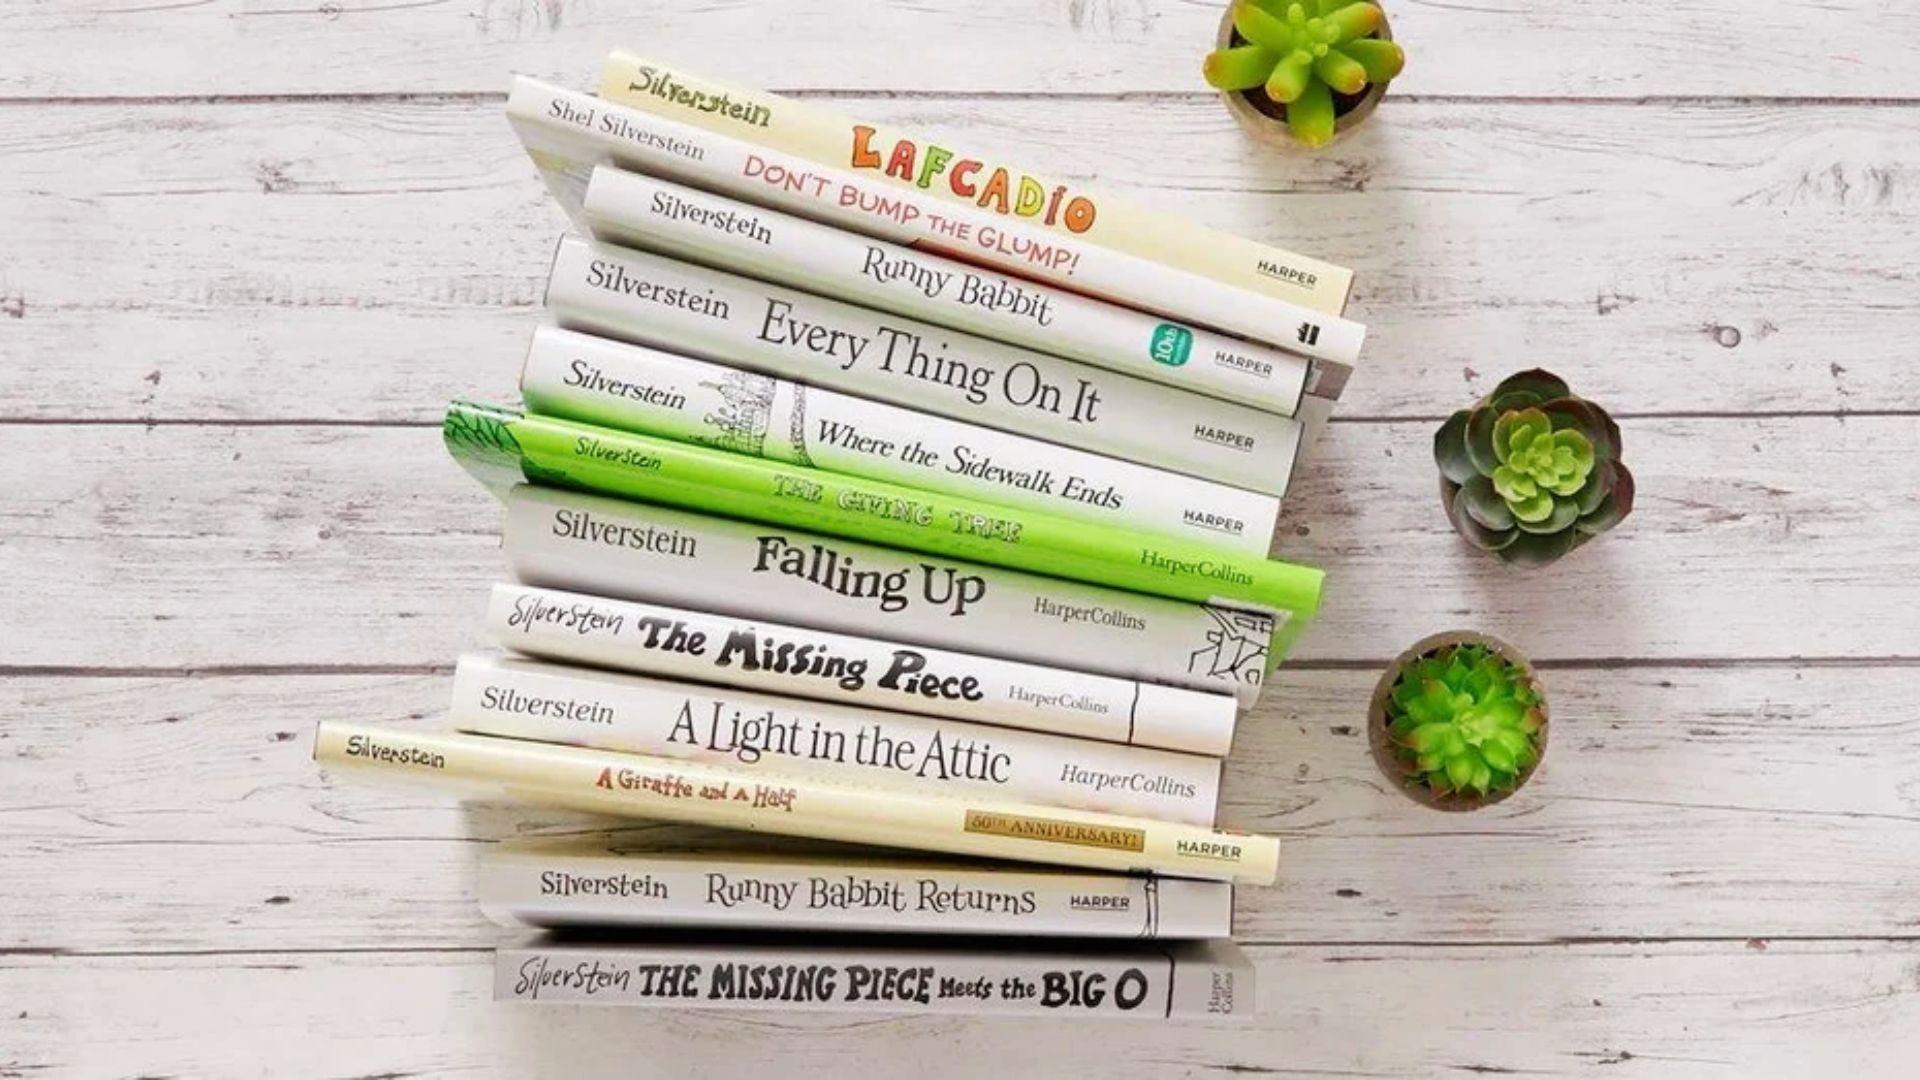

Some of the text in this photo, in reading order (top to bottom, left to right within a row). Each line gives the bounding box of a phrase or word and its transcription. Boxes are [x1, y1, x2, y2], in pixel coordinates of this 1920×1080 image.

[629, 65, 771, 127] Silverstein
[548, 98, 706, 161] Shel Silverstein
[651, 192, 772, 245] Silverstein
[743, 154, 1080, 275] DON'T BUMP THE GLUMP!
[586, 260, 729, 320] Silverstein
[861, 246, 1053, 326] Runny Babbit
[1257, 260, 1318, 284] HARPER
[757, 297, 1102, 423] Every Thing On It
[1214, 350, 1273, 374] HARPER
[563, 359, 686, 410] Silverstein
[1194, 424, 1254, 448] HARPER
[818, 419, 1123, 510] Where the Sidewalk Ends
[773, 473, 1023, 543] THE GIVING TREE
[1183, 509, 1244, 533] HARPER
[553, 509, 697, 557] Silverstein
[753, 536, 986, 616] Falling Up
[1140, 548, 1254, 586] HarperCollins
[1033, 596, 1146, 631] HarperCollins
[638, 616, 983, 700] The Missing Piece
[481, 686, 614, 725] Silverstein
[1008, 684, 1109, 715] HarperCollins
[346, 735, 445, 769] Silverstein
[667, 699, 1011, 784] A Light in the Attic
[596, 767, 613, 789] A
[618, 768, 692, 797] Giraffe
[700, 782, 729, 800] and
[752, 784, 797, 812] Half
[1060, 764, 1196, 799] HarperCollins
[1011, 820, 1137, 847] ANNIVERSARY!
[1176, 840, 1242, 858] HARPER
[540, 871, 668, 899] Silverstein
[706, 873, 1036, 915] Runny Babbit Returns
[1070, 895, 1130, 909] HARPER
[639, 964, 702, 998] THE
[706, 964, 837, 1002] MISSING
[844, 966, 935, 1004] PIECE
[1000, 975, 1036, 999] the
[1040, 971, 1105, 1009] BIG
[1116, 968, 1148, 1009] O
[1208, 972, 1221, 1012] Harper
